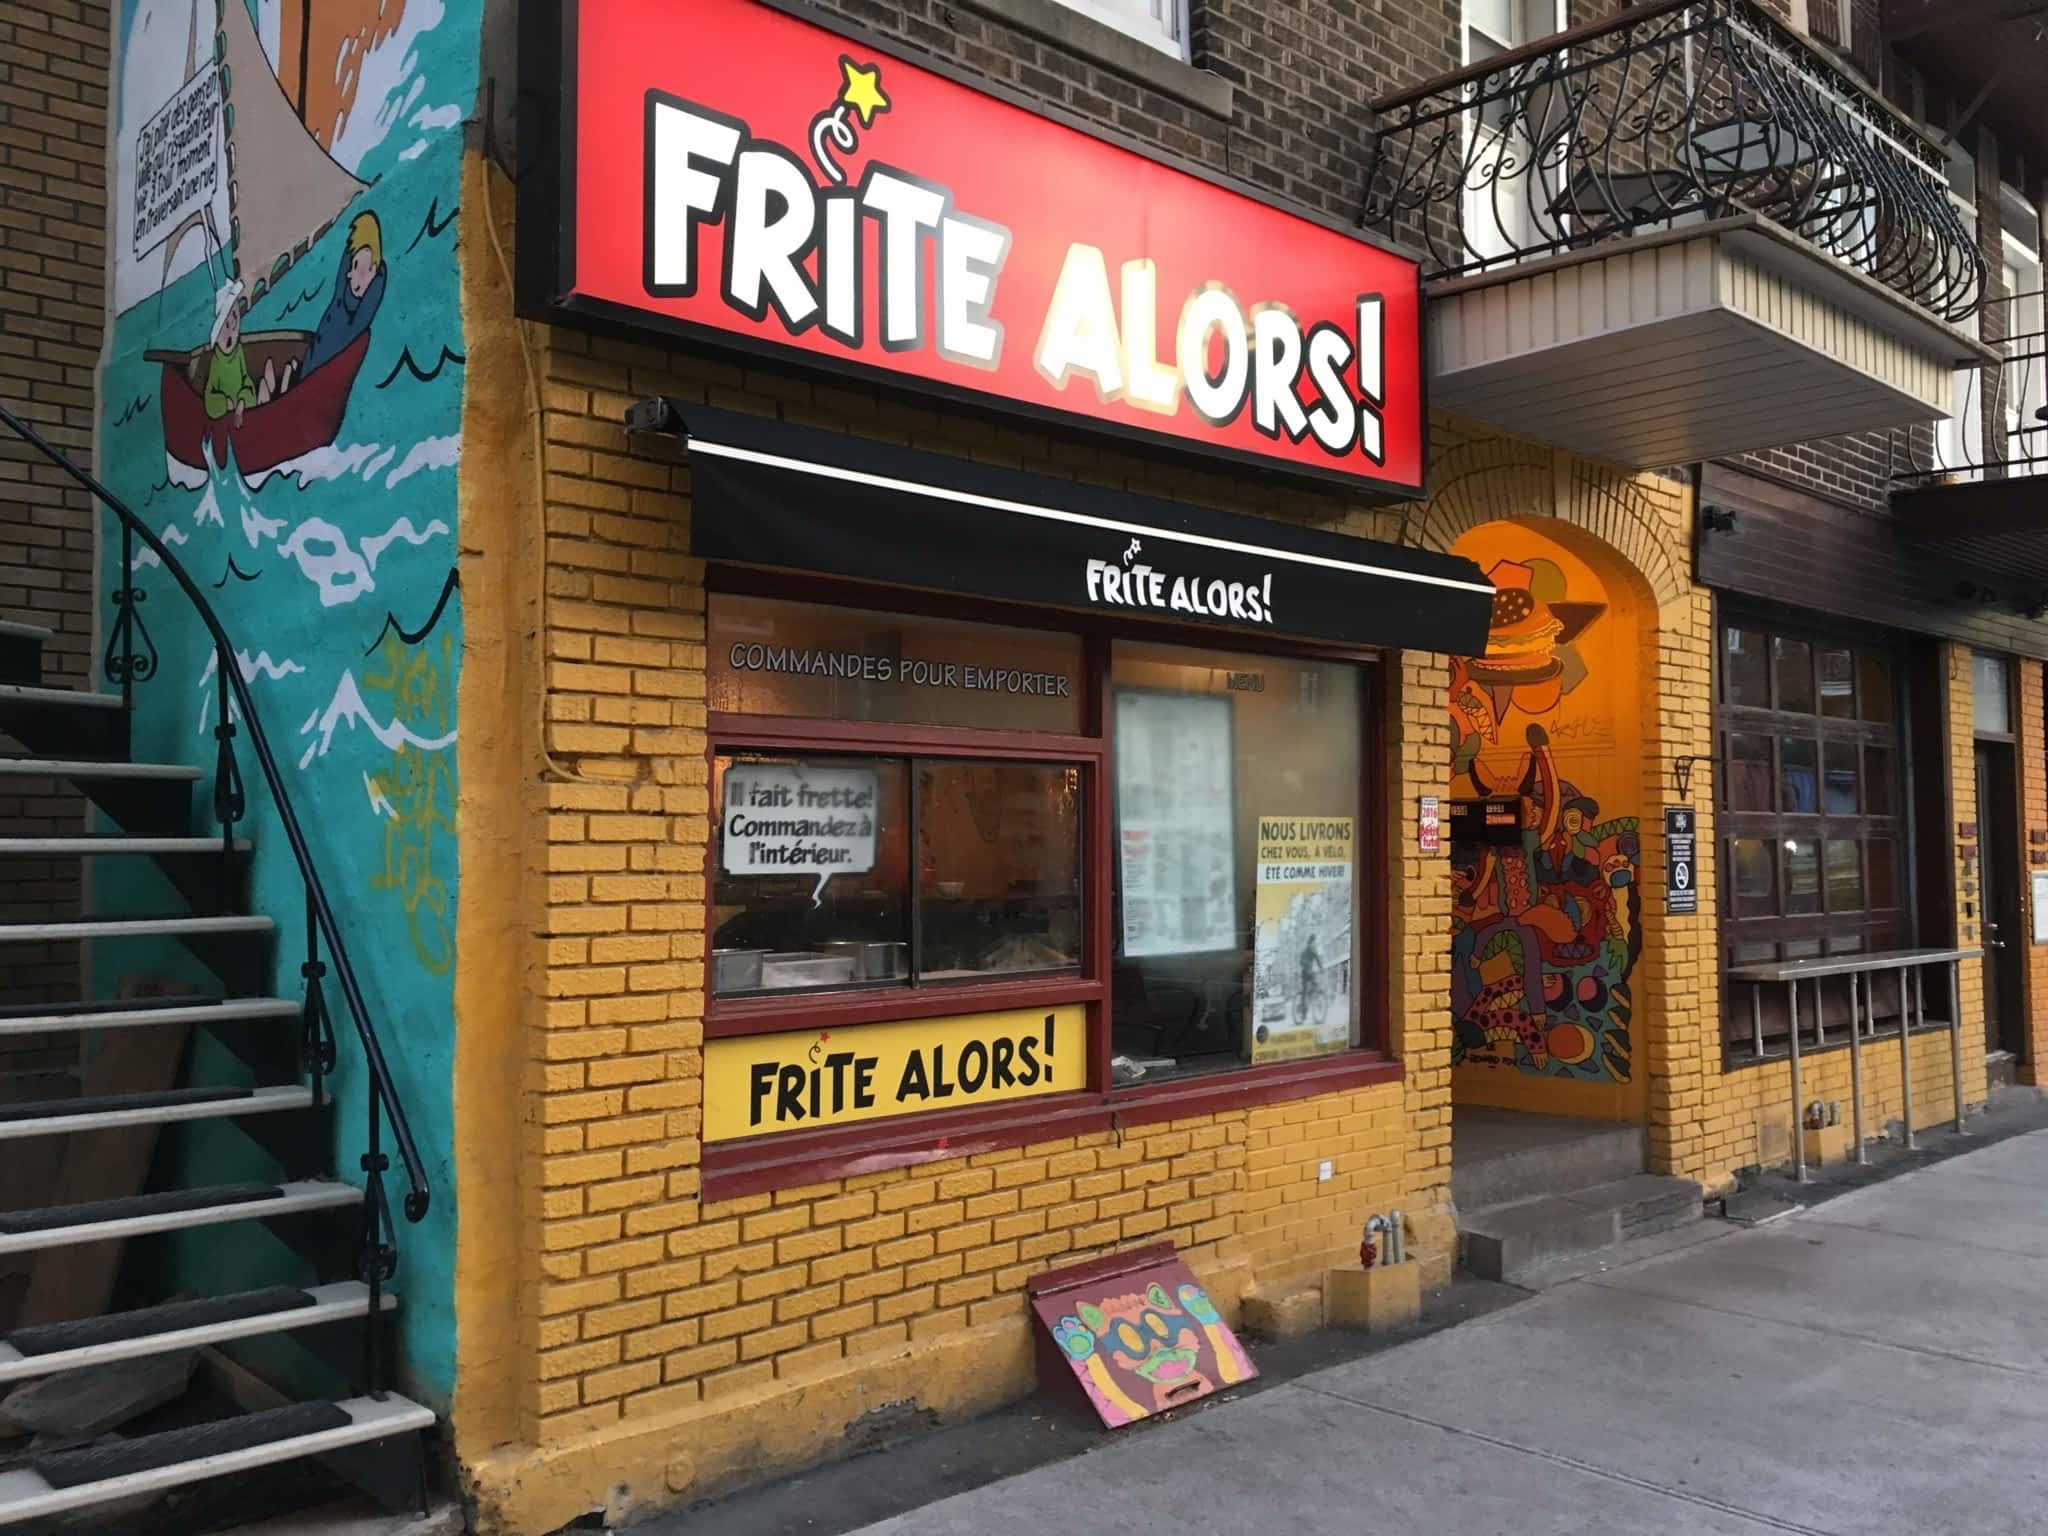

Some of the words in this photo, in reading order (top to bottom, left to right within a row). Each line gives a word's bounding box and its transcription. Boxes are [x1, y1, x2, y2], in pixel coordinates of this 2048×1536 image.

[176, 132, 212, 180] moment
[644, 88, 1011, 371] FRITE
[1034, 242, 1385, 467] ALORS!
[1086, 558, 1166, 607] FRITE
[1170, 573, 1273, 624] ALORS!
[729, 642, 892, 682] COMMANDES
[899, 660, 958, 688] POUR
[963, 666, 1069, 698] EMPORTER
[730, 781, 744, 807] Il
[749, 781, 794, 807] fait
[797, 782, 873, 808] frette!
[729, 814, 857, 838] Commandez
[858, 813, 872, 838] à
[1261, 822, 1296, 841] NOUS
[1300, 822, 1350, 841] LIVRONS
[748, 839, 853, 864] l'intérieur.
[1261, 846, 1283, 859] CHEZ
[1266, 865, 1281, 880] ÉTÉ
[1283, 866, 1315, 879] COMME
[750, 1051, 878, 1126] FRITE
[896, 1013, 1056, 1103] ALORS!
